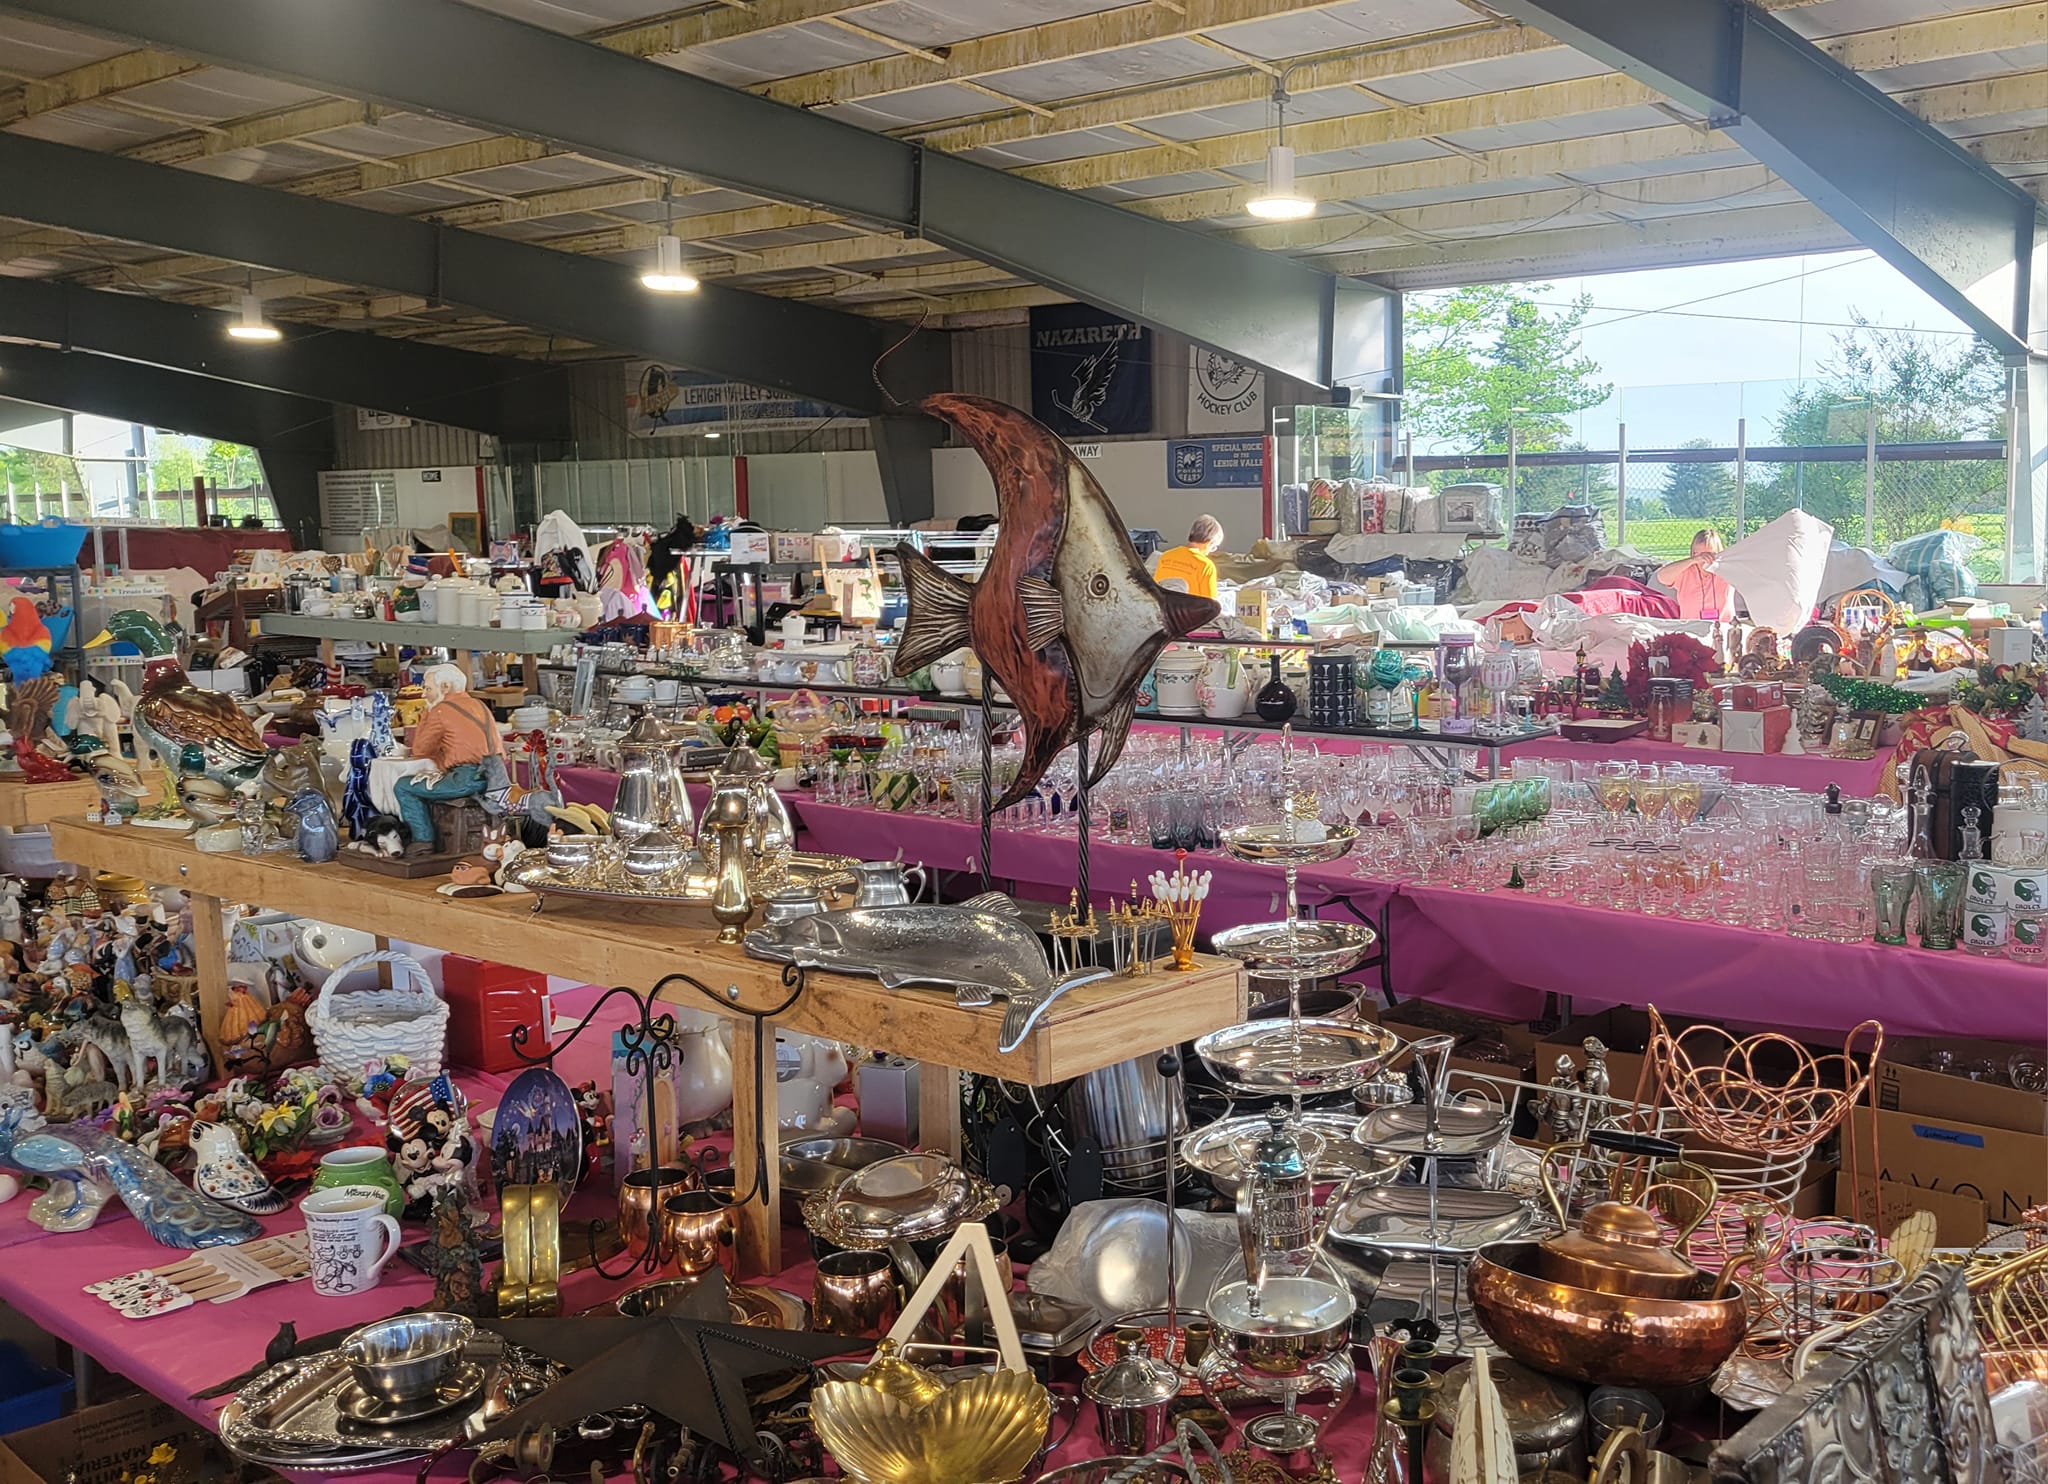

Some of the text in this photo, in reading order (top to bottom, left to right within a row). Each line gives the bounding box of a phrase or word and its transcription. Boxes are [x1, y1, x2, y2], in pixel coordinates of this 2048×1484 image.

[1036, 324, 1143, 347] NAZARETH
[684, 387, 721, 405] LEHIGH
[1197, 391, 1258, 415] HOCKEY CLUB
[1073, 445, 1099, 457] AWAY
[1211, 443, 1241, 452] SPECIAL
[1213, 458, 1263, 468] LEHIGH VALLE
[423, 471, 440, 481] HOME
